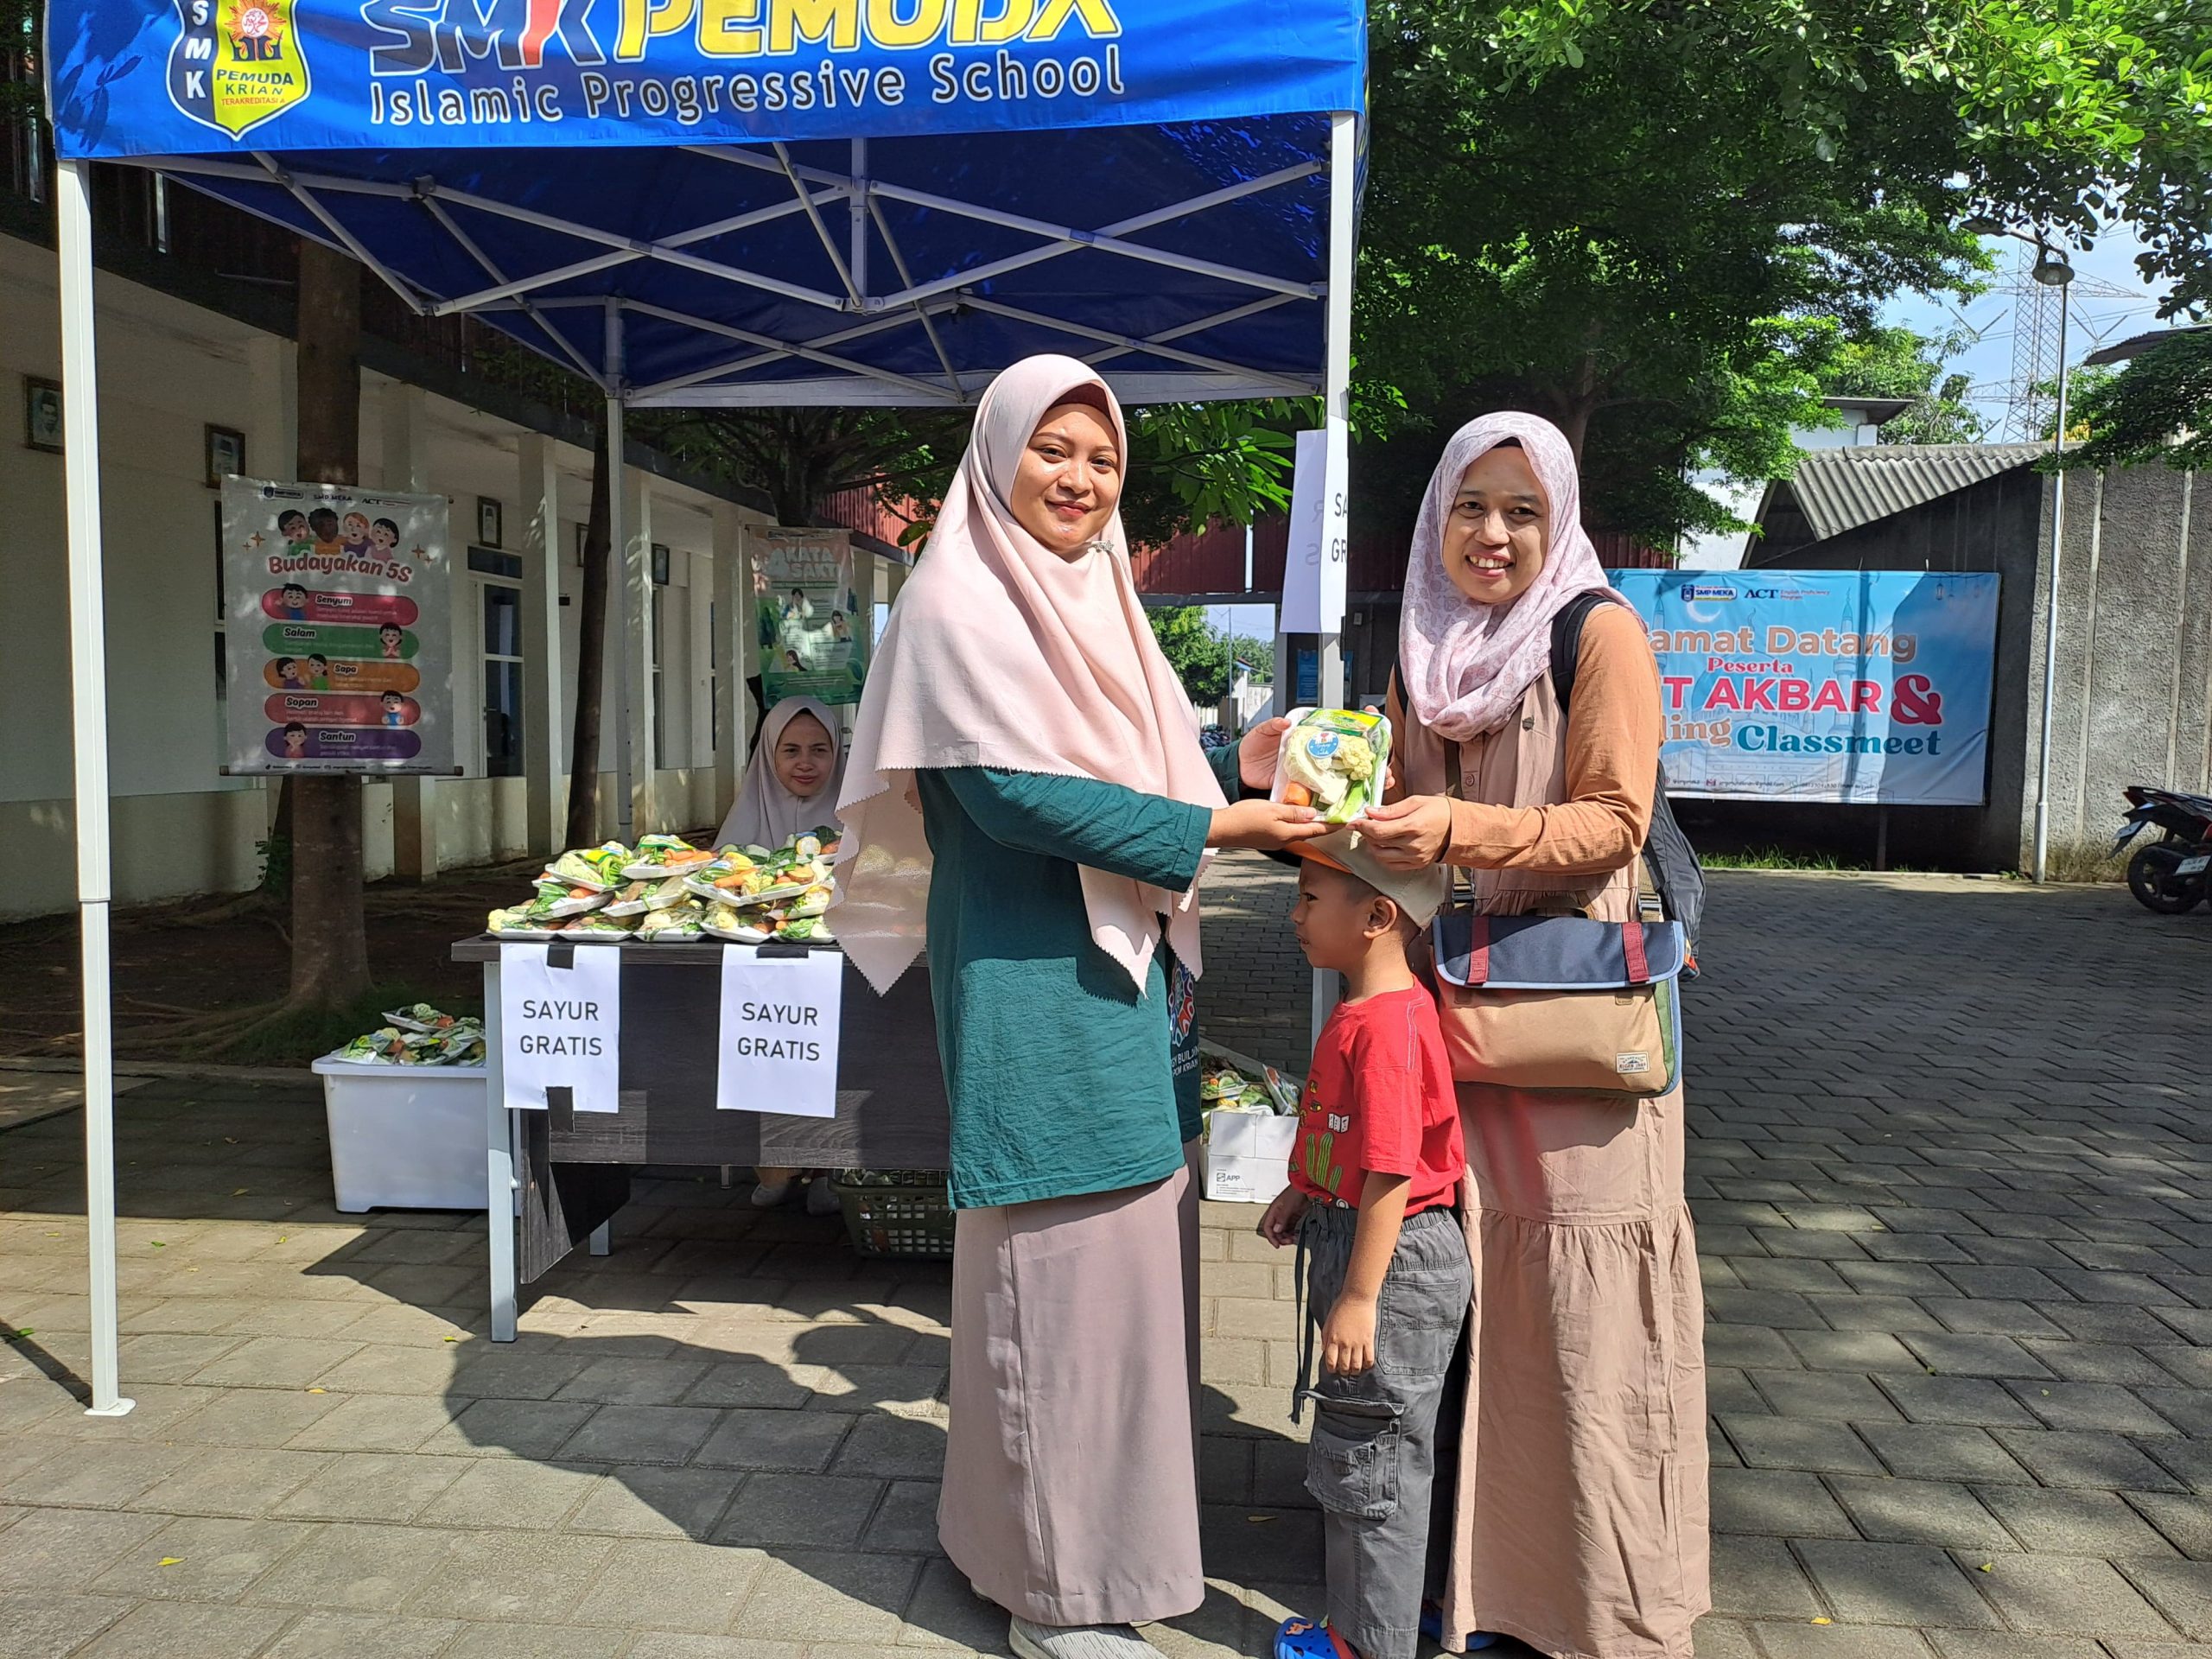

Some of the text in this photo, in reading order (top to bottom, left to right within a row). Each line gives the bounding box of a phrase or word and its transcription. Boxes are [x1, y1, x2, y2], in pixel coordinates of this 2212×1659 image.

[216, 68, 295, 86] PEMUDA
[371, 44, 1124, 124] Islamic Progressive School
[226, 83, 283, 95] KRIAN
[221, 97, 278, 105] TERAKREDITASI
[268, 553, 413, 583] Budayakan 5S
[315, 594, 353, 607] Senyum
[1745, 589, 1778, 599] ACT
[283, 627, 315, 638] Salam
[1766, 626, 1916, 662] Datang
[334, 664, 357, 674] Sapa
[1707, 657, 1794, 674] Peserta
[285, 697, 317, 708] Sopan
[1703, 677, 1884, 714] AKBAR
[1890, 674, 1942, 726] &
[319, 732, 355, 741] Santun
[1737, 724, 1942, 756] Classmeet
[523, 1000, 600, 1021] SAYUR
[741, 1002, 818, 1027] SAYUR
[519, 1034, 602, 1056] GRATIS
[737, 1037, 820, 1061] GRATIS
